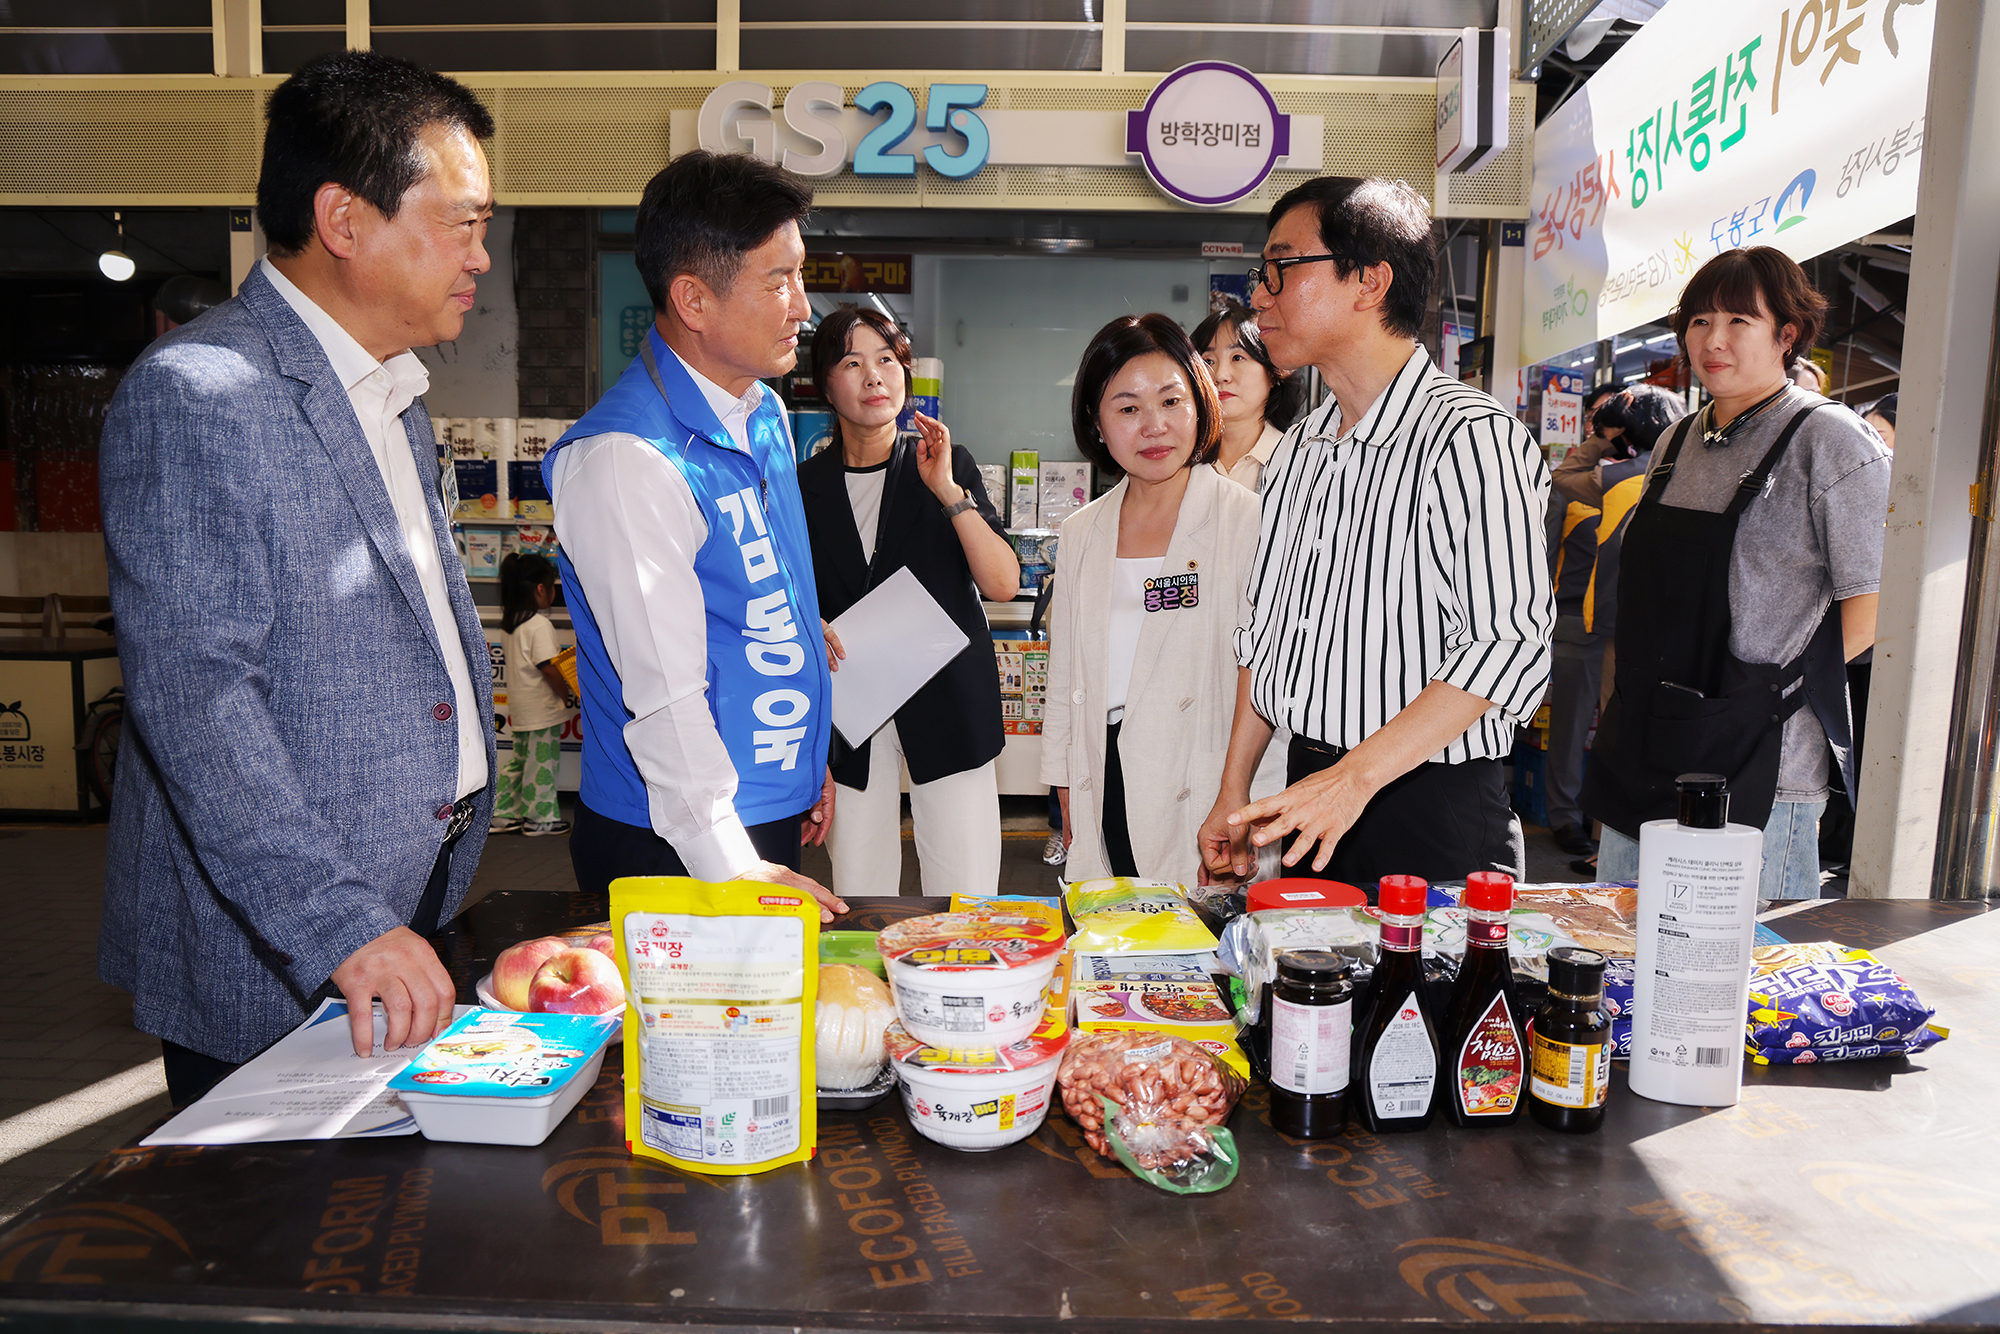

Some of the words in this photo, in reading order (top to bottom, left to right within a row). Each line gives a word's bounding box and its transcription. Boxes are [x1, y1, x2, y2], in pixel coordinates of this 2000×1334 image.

[1438, 82, 1460, 131] GS25
[697, 80, 990, 181] GS25
[1160, 121, 1261, 148] 방학장미점
[234, 215, 249, 225] 1-1
[1506, 230, 1522, 239] 1-1
[862, 262, 907, 285] 구마
[1561, 414, 1577, 434] 1+1
[1154, 575, 1197, 589] 서울시의원
[1145, 585, 1198, 611] 홍은정
[1673, 884, 1688, 899] 17
[912, 948, 992, 963] BIG
[1470, 1030, 1517, 1061] 참소스
[933, 1103, 973, 1124] 육개장
[974, 1101, 997, 1116] BIG
[868, 1116, 928, 1182] PLYWOOD
[817, 1123, 934, 1290] ECOFORM
[903, 1182, 959, 1235] FACED
[931, 1235, 983, 1278] FILM
